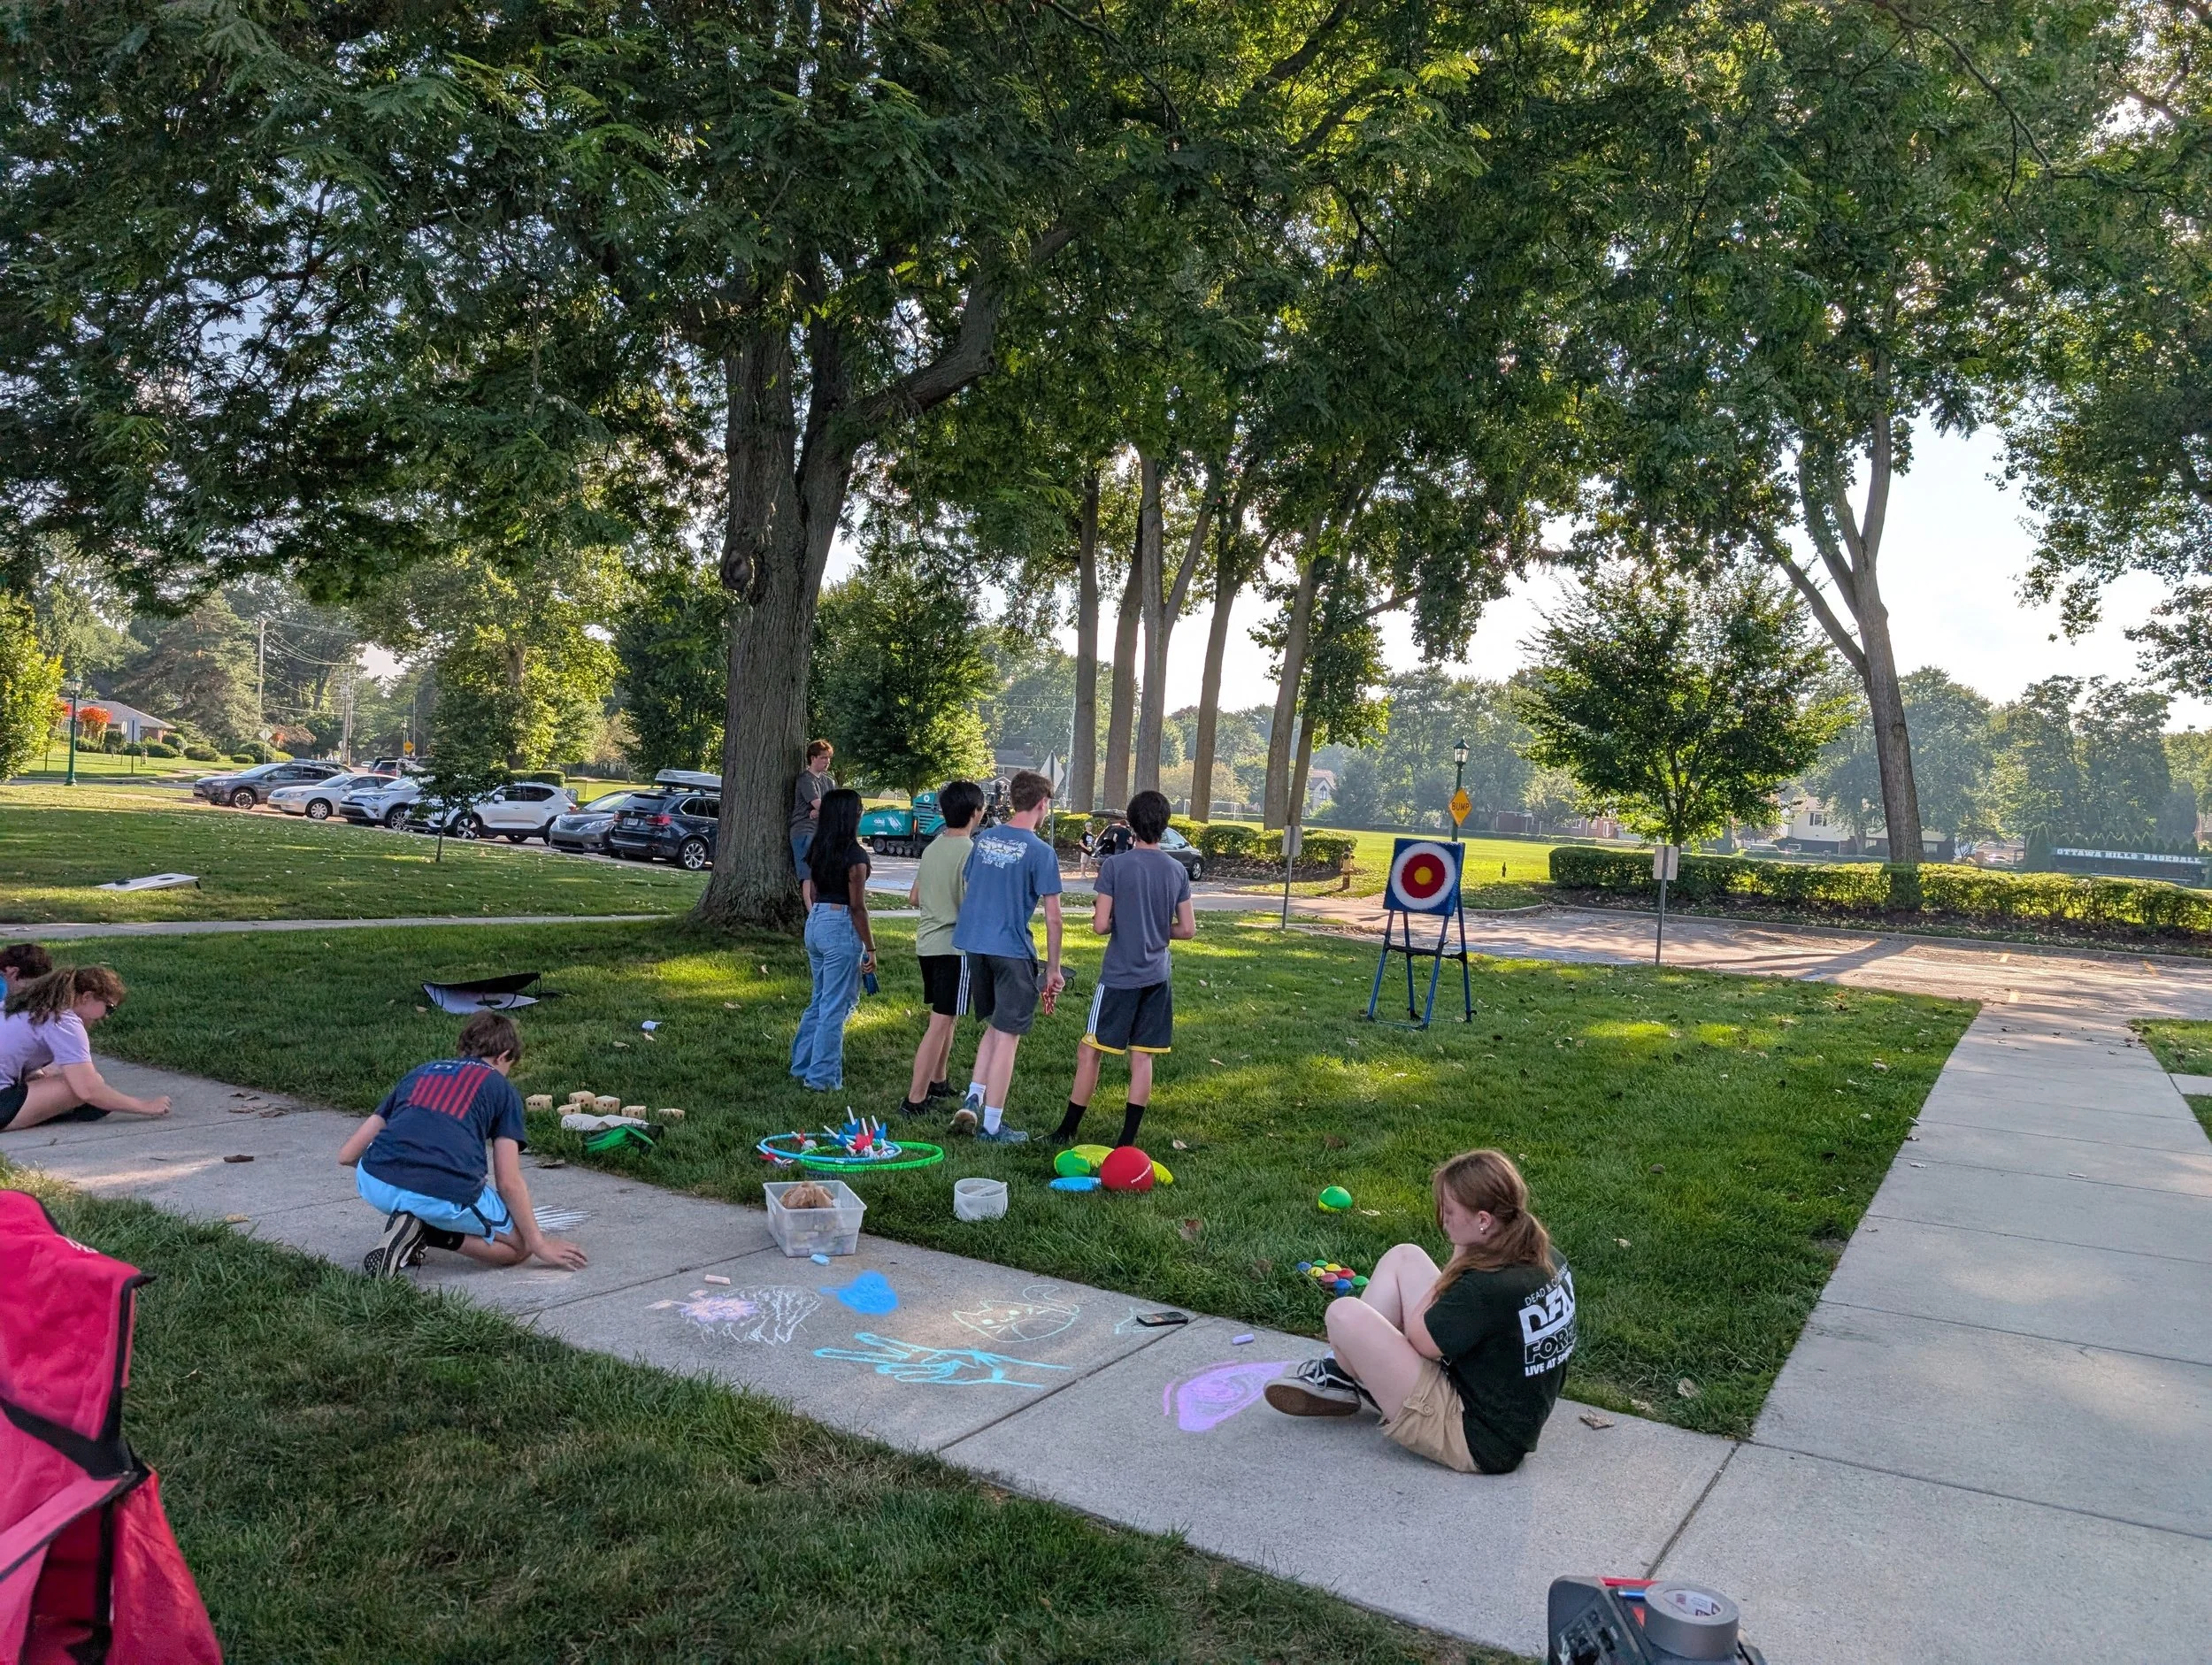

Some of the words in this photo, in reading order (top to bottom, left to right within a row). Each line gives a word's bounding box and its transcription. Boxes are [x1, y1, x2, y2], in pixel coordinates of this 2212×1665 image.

[1451, 802, 1470, 811] BUMP
[2056, 848, 2102, 858] OTTAWA
[2105, 851, 2139, 860] HILLS
[2143, 853, 2202, 864] BASEBALL
[1525, 1287, 1546, 1307] DEAD
[1545, 1282, 1553, 1293] &
[1525, 1362, 1545, 1377] LIVE
[1546, 1357, 1556, 1370] AT
